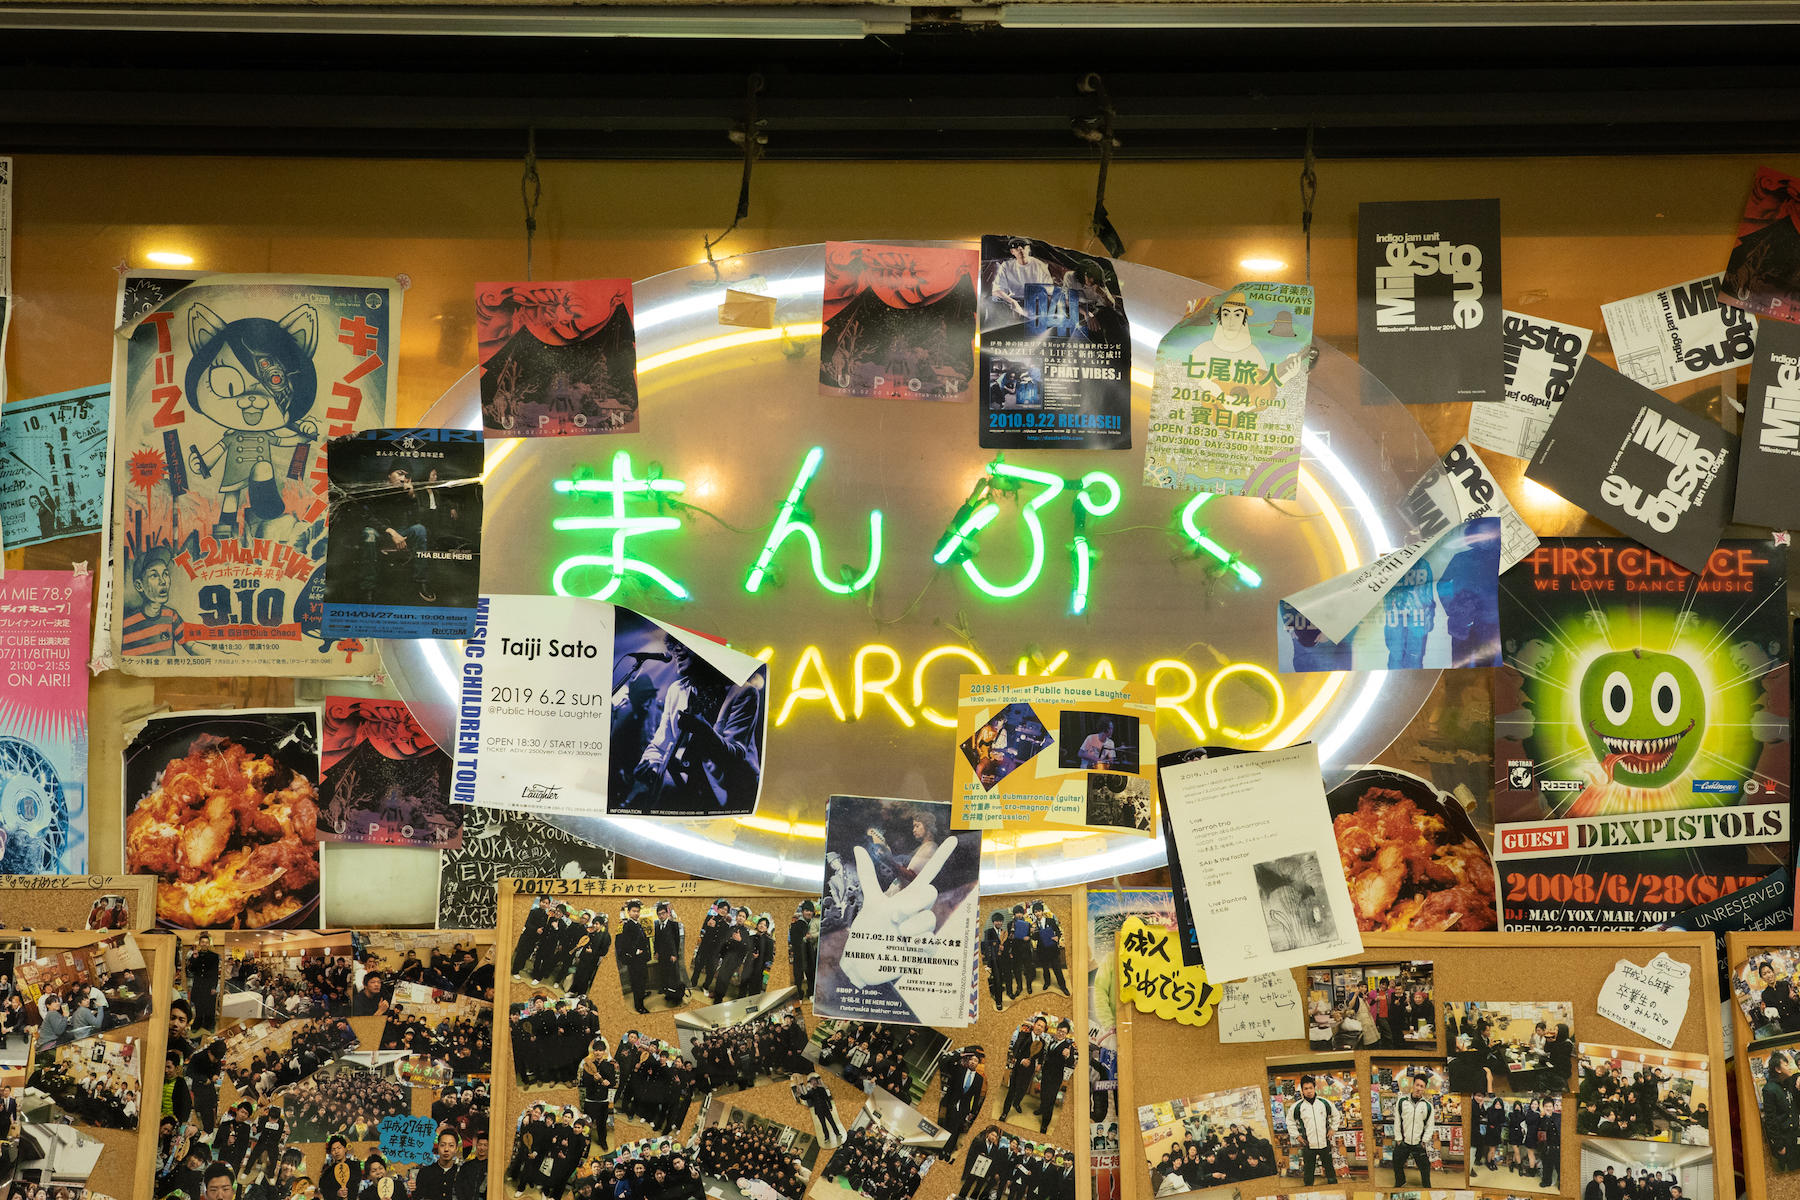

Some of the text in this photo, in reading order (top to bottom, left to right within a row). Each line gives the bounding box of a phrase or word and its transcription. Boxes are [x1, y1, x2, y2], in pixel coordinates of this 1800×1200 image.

[1376, 232, 1440, 244] indigo jam unit
[1249, 293, 1313, 305] MAGICWAYS
[1770, 353, 1797, 366] indigo
[1182, 354, 1284, 388] 七尾旅人
[1171, 387, 1250, 408] 2016.4.24
[989, 413, 1121, 430] 2010.9.22 RELEASE!!
[1169, 408, 1185, 421] at
[1153, 422, 1295, 445] OPEN 18:30 START 19:00
[1155, 435, 1200, 447] ADV:3000
[1204, 440, 1248, 452] DAY:3500
[552, 446, 1262, 617] まんぷく
[270, 542, 315, 583] LIVE
[1520, 547, 1769, 577] FIRST CHCE
[233, 579, 260, 589] 2016
[1534, 580, 1754, 593] WE LOVE DANCE MUSIC
[11, 587, 73, 601] MIE 78.9
[198, 584, 286, 627] 9.10
[7, 635, 37, 646] CUBE
[501, 638, 598, 660] Taiji Sato
[8, 673, 72, 687] ON AIR!!
[491, 686, 602, 706] 2019 6.2 sun
[971, 684, 1010, 694] 2019.5.11
[1033, 686, 1061, 694] Public
[1064, 687, 1092, 696] house
[1094, 689, 1131, 700] Laughter
[454, 598, 490, 803] MUSIC CHILDREN TOUR
[488, 706, 602, 720] @Public House Laughter
[487, 737, 513, 746] OPEN
[517, 738, 541, 747] 18:30
[550, 739, 577, 748] START
[580, 741, 603, 750] 19:00
[521, 783, 563, 802] Laughter
[1056, 794, 1084, 803] (guitar)
[1004, 803, 1049, 812] cro-magnon
[1051, 804, 1080, 813] (drums)
[984, 813, 1030, 821] (percussion)
[1504, 810, 1783, 850] GUEST DEXPISTOLS
[1506, 872, 1768, 906] 2008/6/28(SA
[1695, 881, 1785, 928] UNRESERVED
[1505, 909, 1528, 920] DJ:
[1743, 912, 1753, 924] A
[851, 932, 895, 942] 2017.02.18
[896, 935, 913, 943] SAT
[1124, 928, 1171, 963] 成人
[844, 951, 959, 966] MARRON A.K.A. DUBMARRONICS
[878, 965, 924, 975] JODY TENKU
[381, 1120, 434, 1137] 平成27年度
